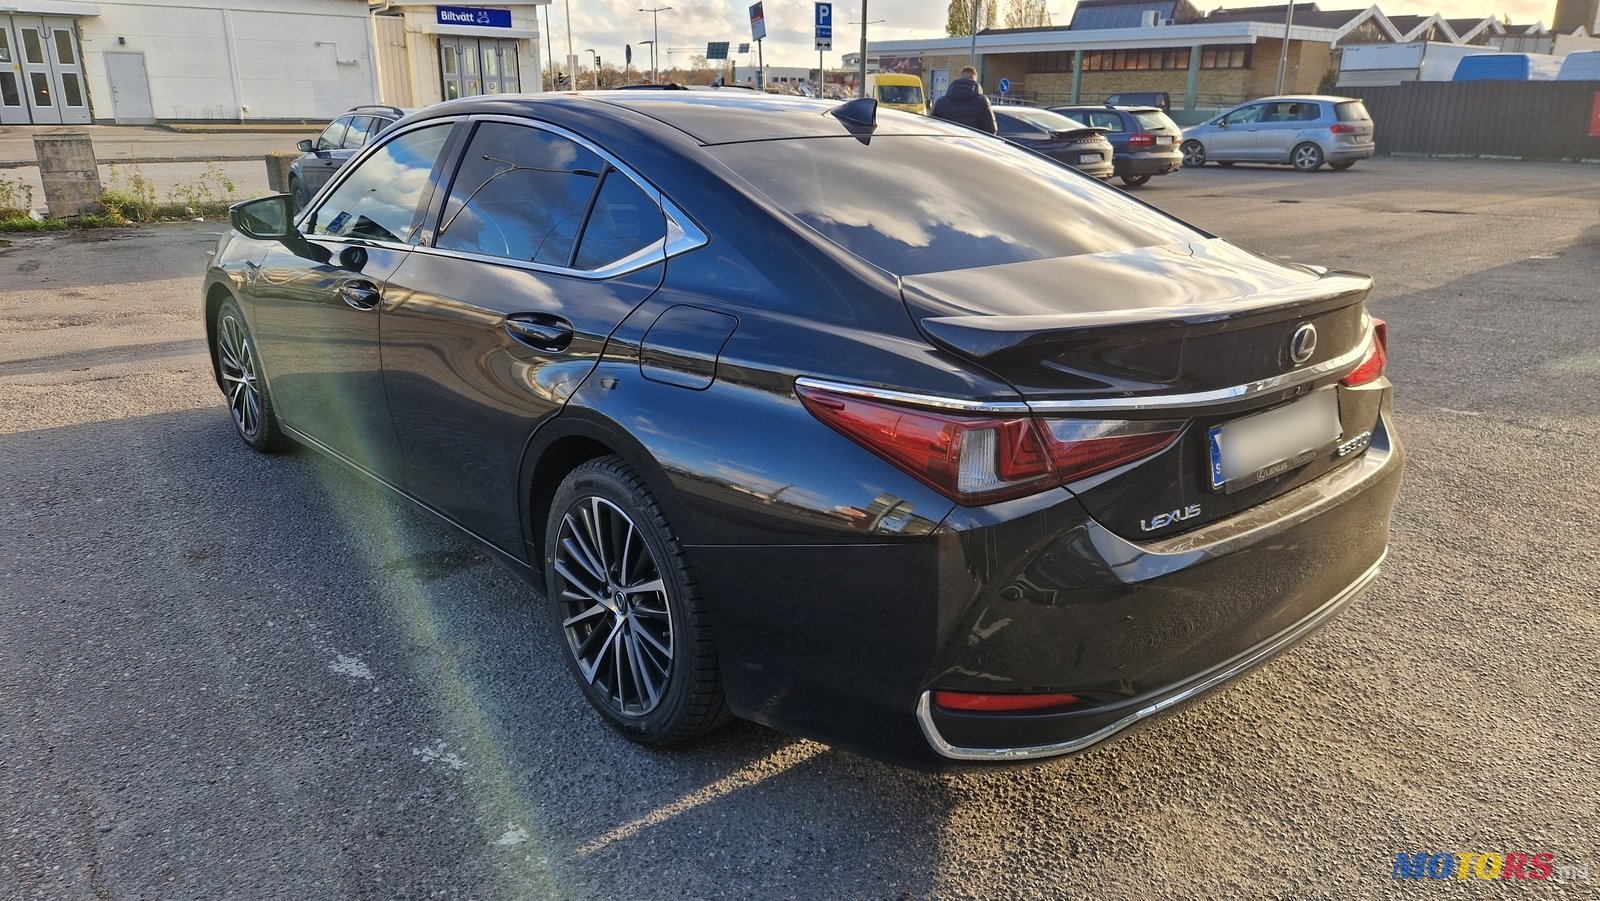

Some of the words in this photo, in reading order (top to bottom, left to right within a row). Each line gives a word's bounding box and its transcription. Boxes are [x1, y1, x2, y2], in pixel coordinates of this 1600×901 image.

[441, 10, 475, 22] Biltvätt
[820, 5, 829, 24] P
[1215, 463, 1221, 474] S
[1265, 462, 1288, 476] LEXUS
[1140, 503, 1202, 532] LEXUS
